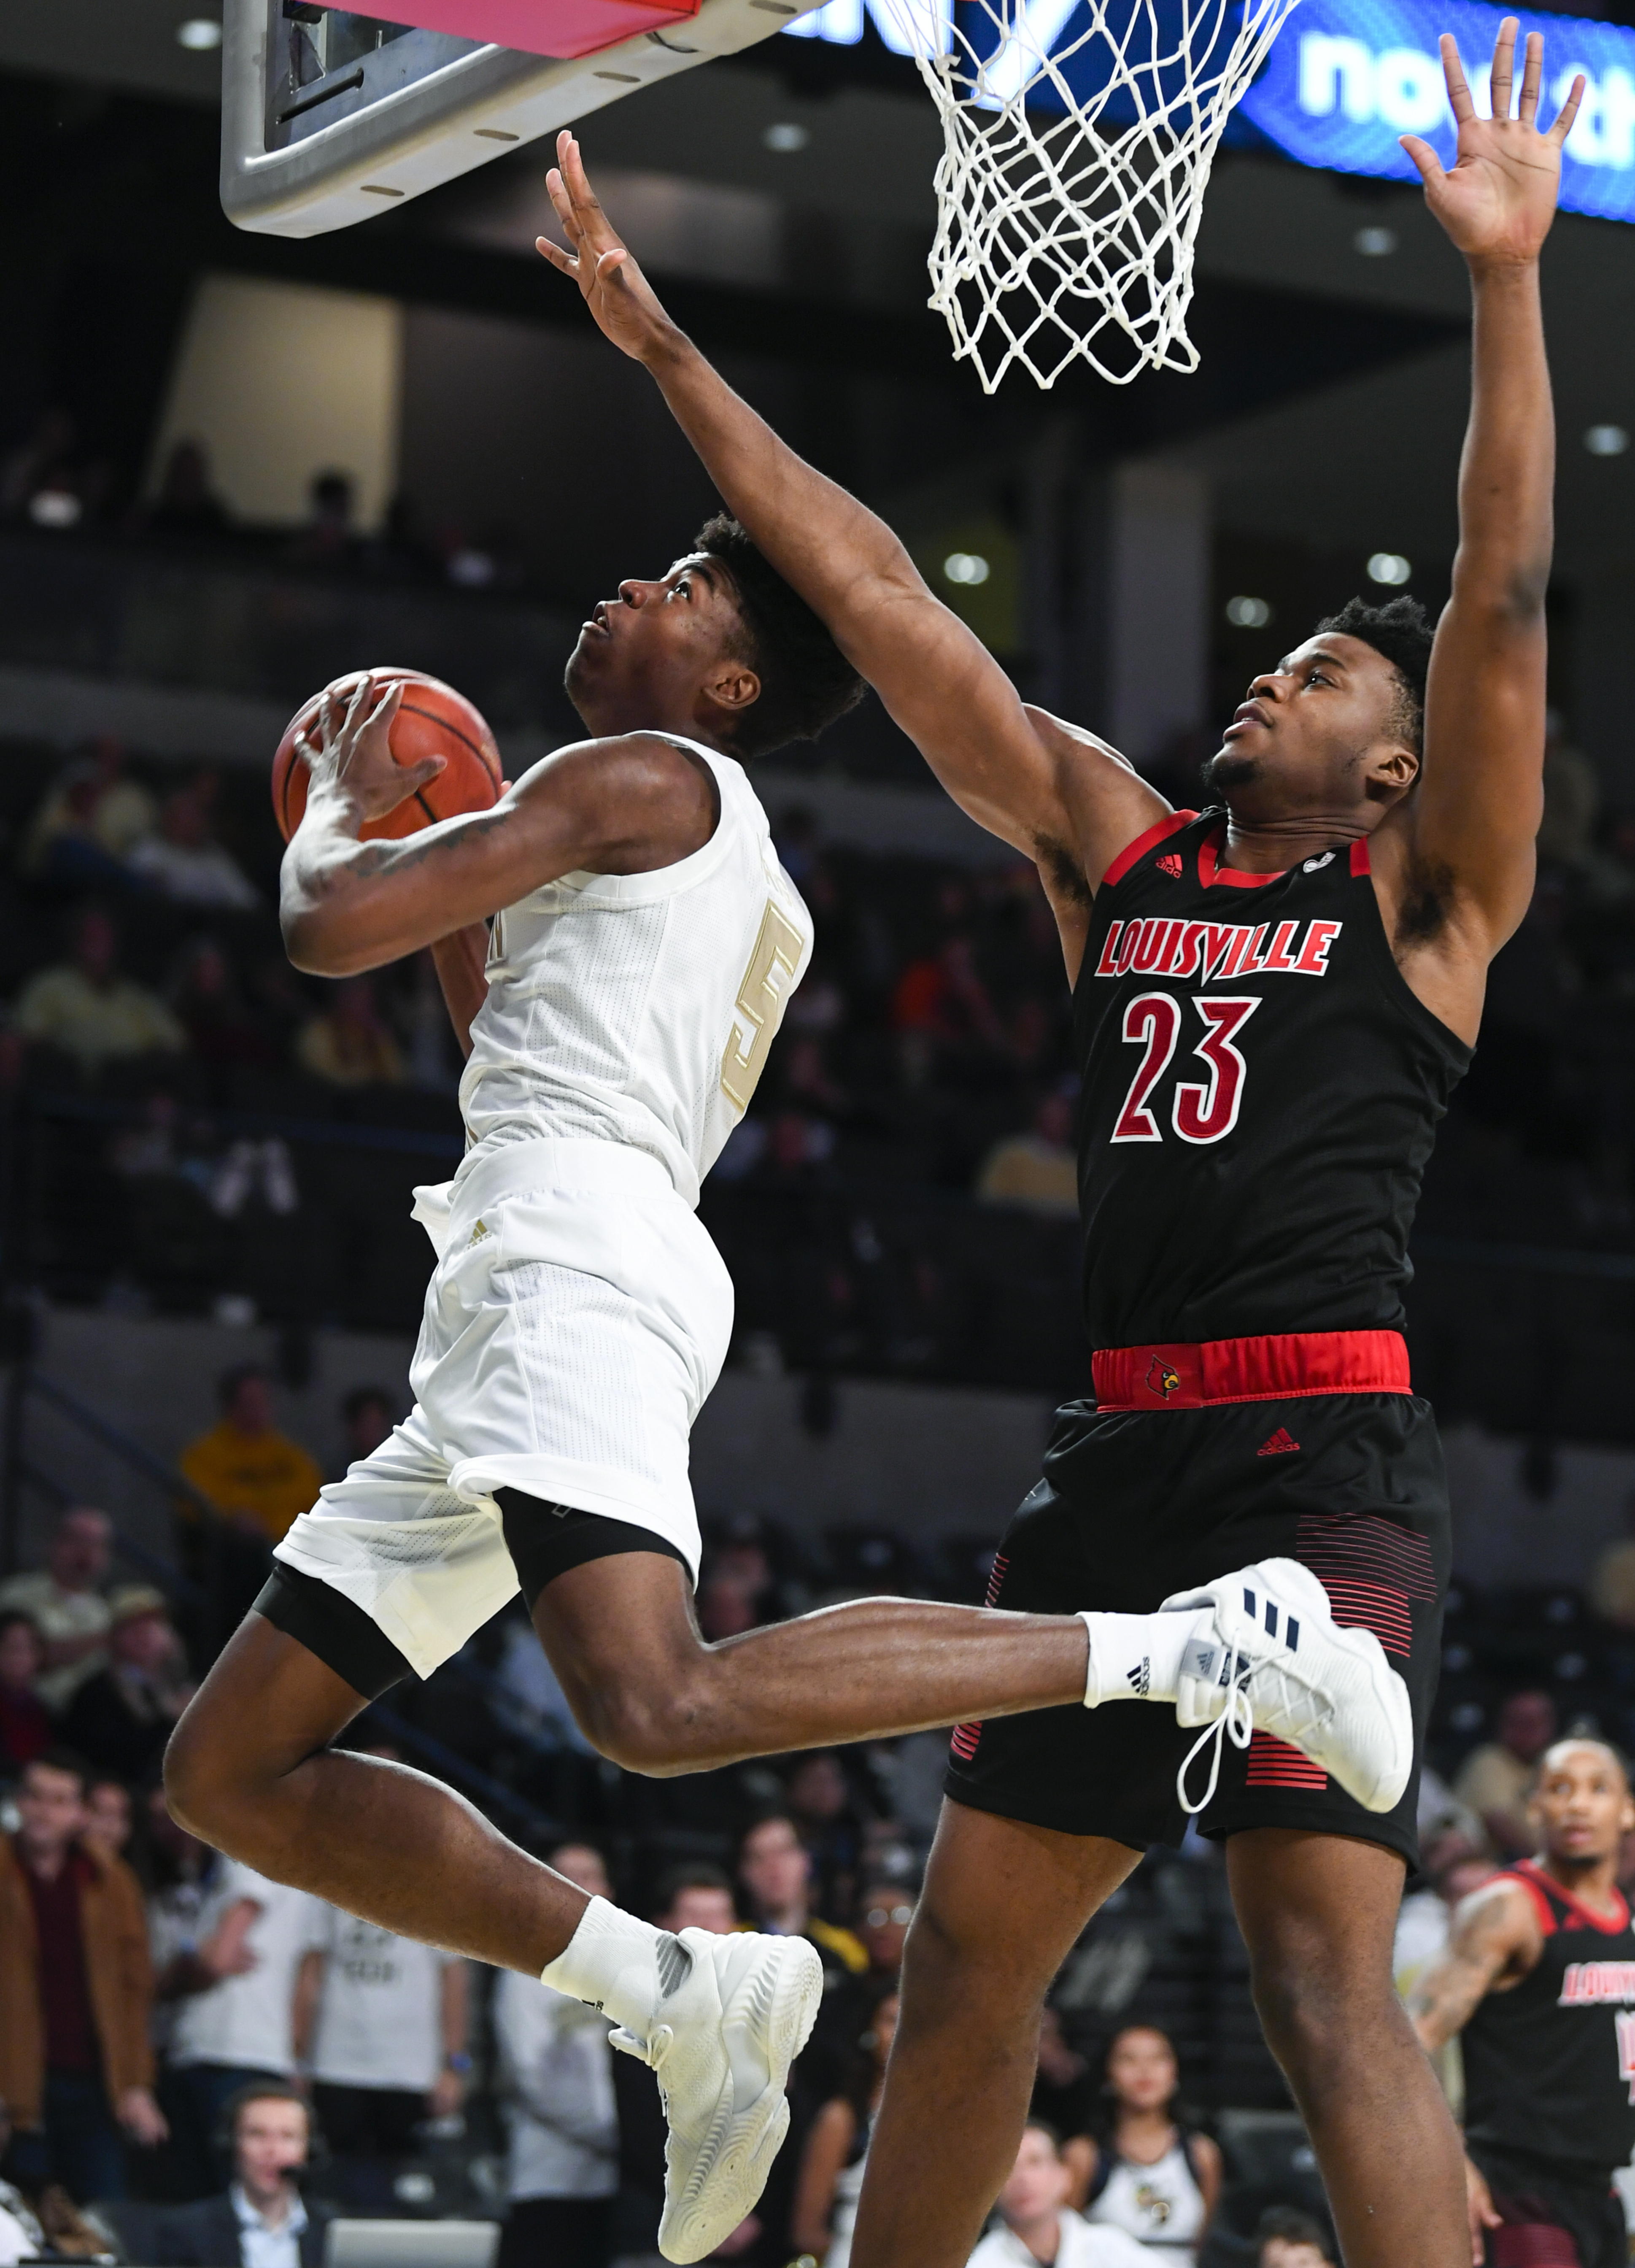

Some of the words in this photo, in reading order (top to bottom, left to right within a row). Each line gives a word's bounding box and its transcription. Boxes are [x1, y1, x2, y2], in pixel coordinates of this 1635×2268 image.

[1094, 917, 1343, 987] LOUISVILLE
[1110, 992, 1263, 1145] 23
[1257, 1442, 1300, 1455] adidas
